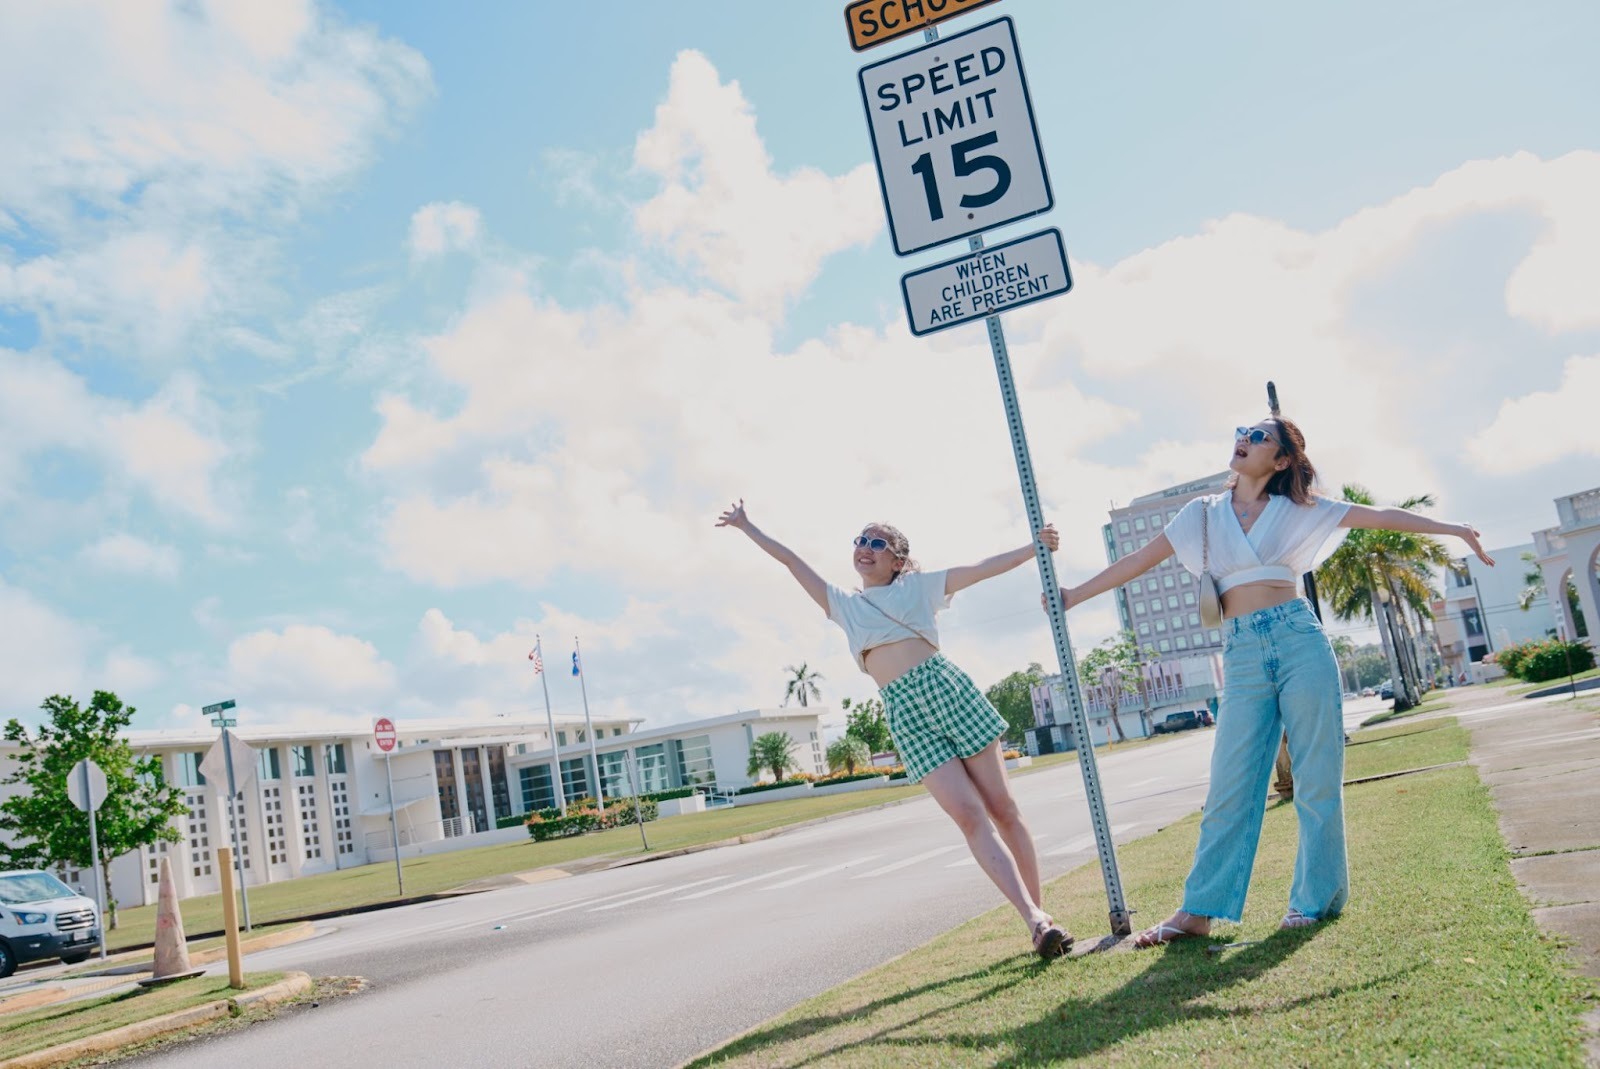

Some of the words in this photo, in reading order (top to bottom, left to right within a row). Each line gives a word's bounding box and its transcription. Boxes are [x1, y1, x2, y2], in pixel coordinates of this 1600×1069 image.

[877, 47, 1006, 112] SPEED
[898, 88, 997, 148] LIMIT
[911, 130, 1012, 222] 15
[942, 263, 1030, 302] CHILDREN
[956, 252, 1006, 280] WHEN
[930, 301, 965, 325] ARE
[972, 274, 1049, 312] PRESENT
